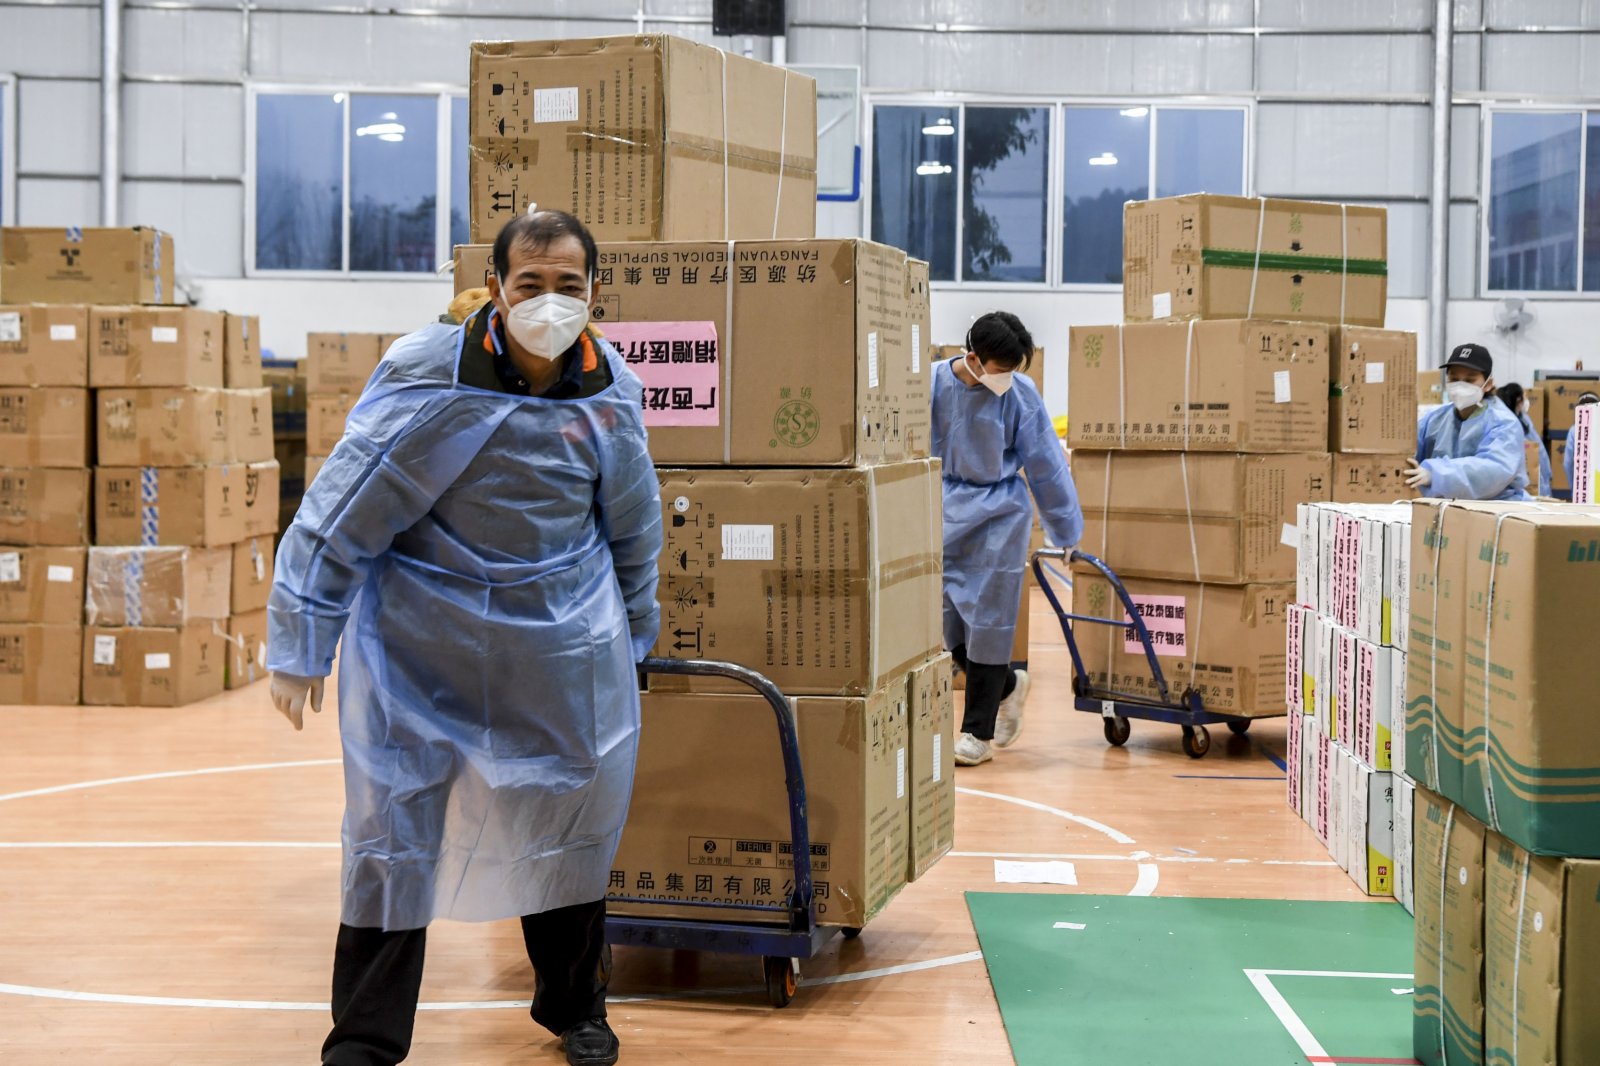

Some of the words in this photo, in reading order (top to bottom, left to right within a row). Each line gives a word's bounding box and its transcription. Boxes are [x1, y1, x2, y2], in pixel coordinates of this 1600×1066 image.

[599, 253, 670, 264] SUPPLIES
[740, 249, 819, 262] FANGYUAN
[736, 841, 772, 853] STERILE
[778, 843, 813, 855] STEE
[745, 857, 763, 866] 无菌
